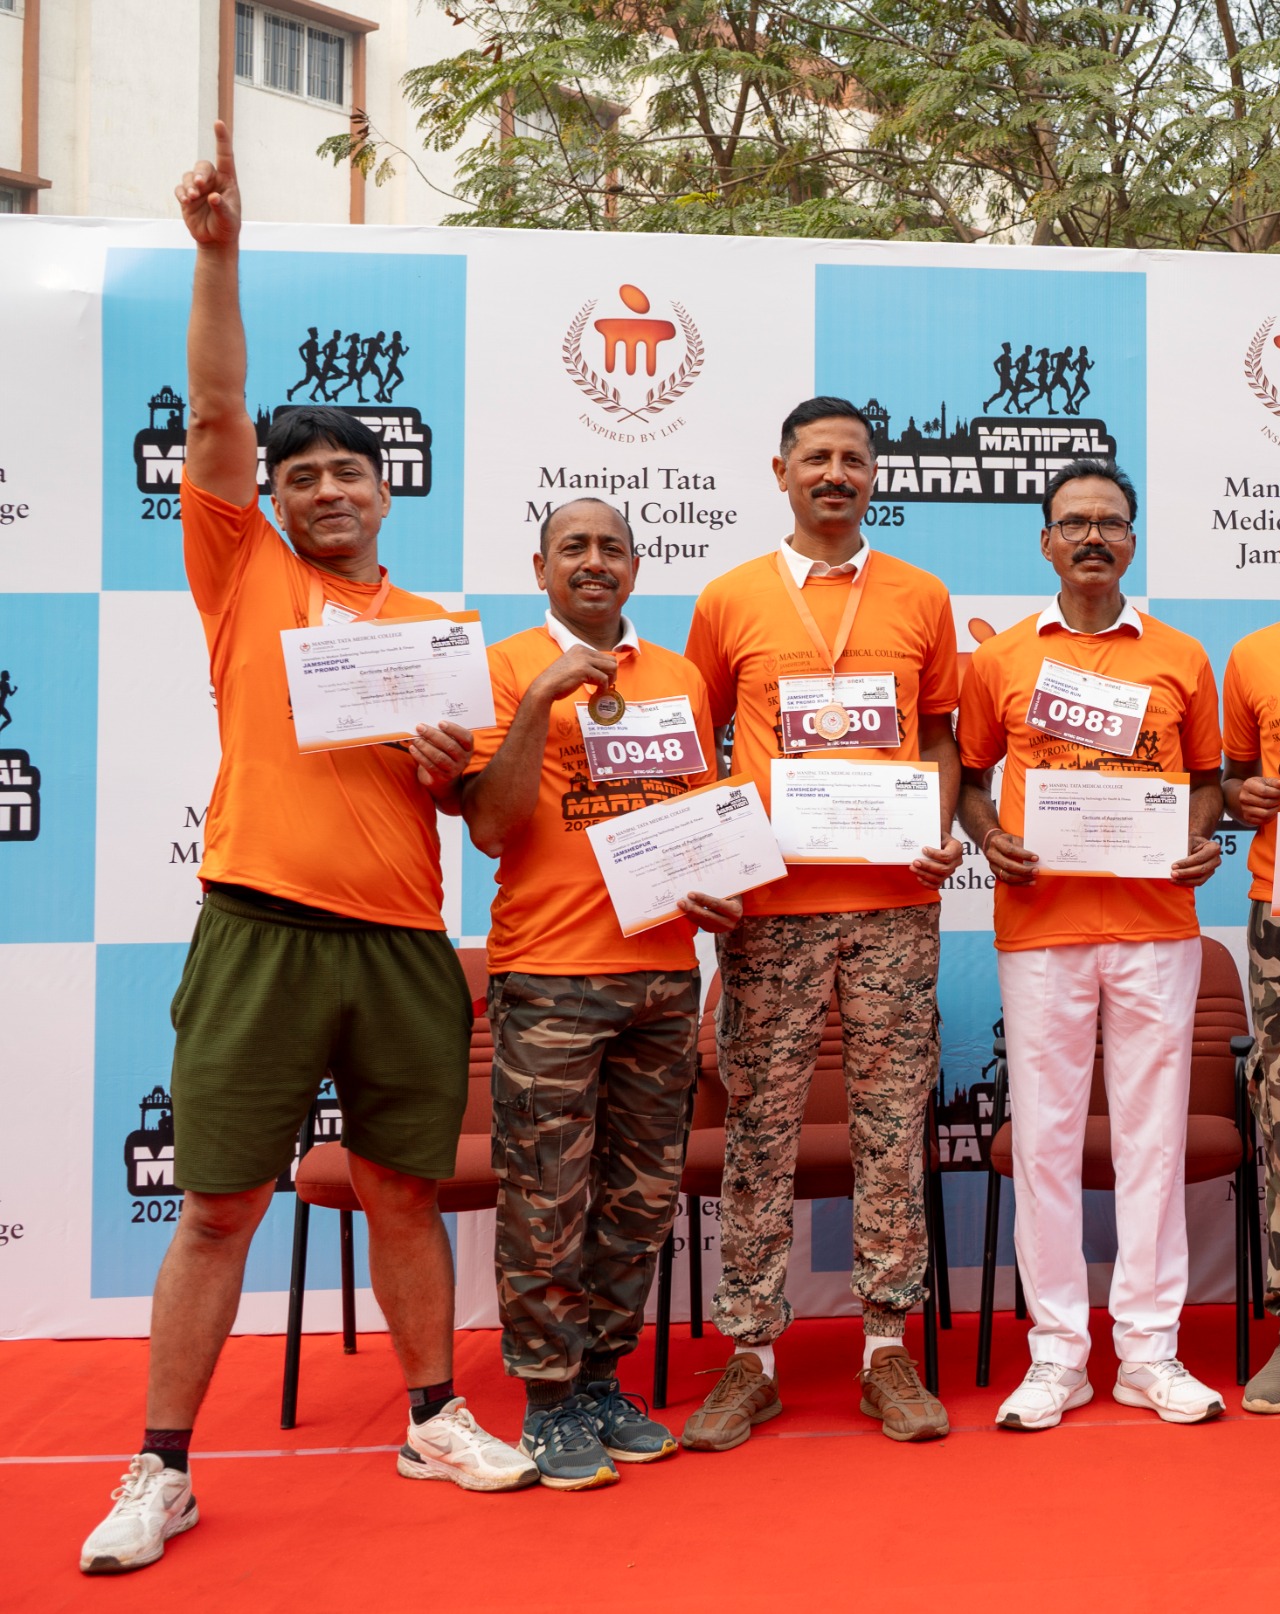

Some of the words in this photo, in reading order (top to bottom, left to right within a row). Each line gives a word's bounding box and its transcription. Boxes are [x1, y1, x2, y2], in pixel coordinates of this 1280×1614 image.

[579, 413, 634, 443] INSPIRED
[640, 432, 657, 443] BY
[661, 417, 686, 437] LIFE
[978, 427, 1109, 453] MANIPAL
[538, 467, 649, 495] Manipal
[657, 468, 716, 490] Tata
[874, 455, 1073, 494] MARATH
[141, 498, 182, 520] 202
[641, 502, 737, 530] College
[861, 506, 905, 526] 025
[634, 536, 709, 564] edpur
[302, 658, 349, 668] JAMSHEDPUR
[779, 651, 815, 661] MANIPAL
[875, 649, 906, 659] COLLEGE
[390, 664, 421, 672] Participation
[1051, 684, 1069, 693] PROMO
[1048, 700, 1123, 737] 0983
[1147, 706, 1168, 714] LLEGE
[802, 709, 881, 734] 080
[607, 738, 684, 763] 0948
[1042, 745, 1079, 757] PROMO
[562, 761, 575, 771] 5K
[613, 841, 651, 858] JAMSHEDPUR
[624, 849, 644, 861] PROMO
[646, 845, 658, 853] RUN
